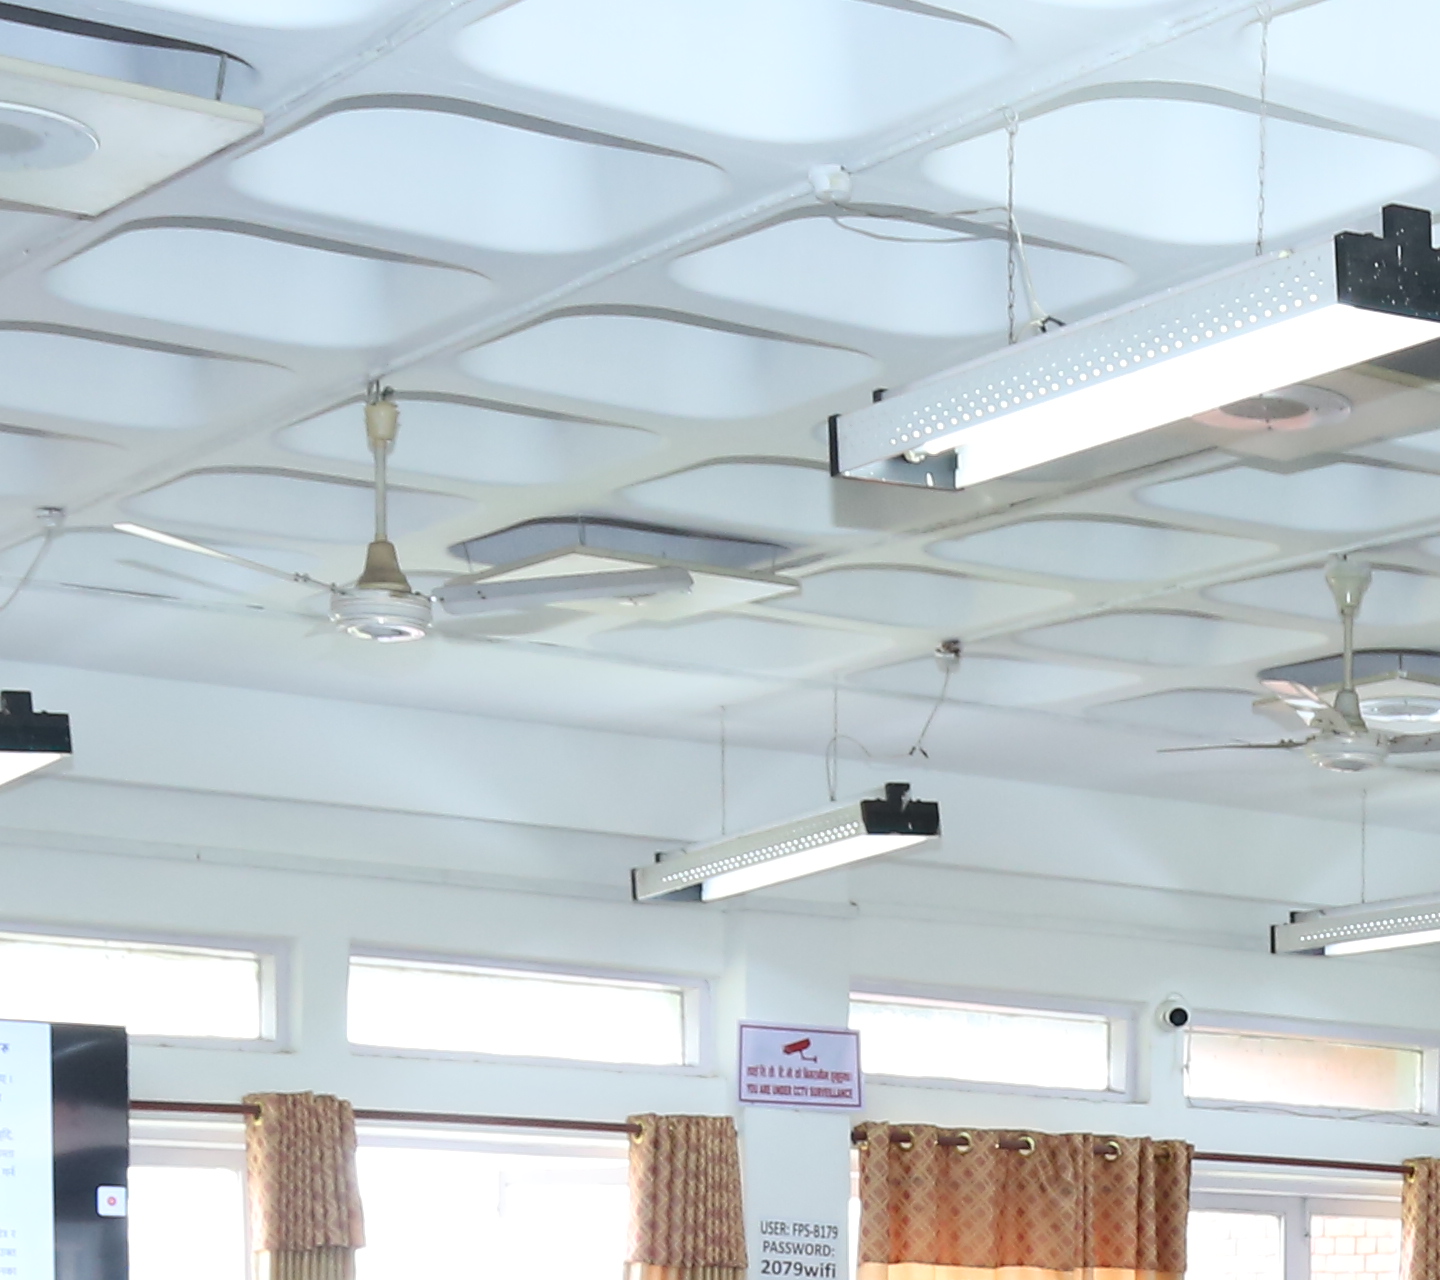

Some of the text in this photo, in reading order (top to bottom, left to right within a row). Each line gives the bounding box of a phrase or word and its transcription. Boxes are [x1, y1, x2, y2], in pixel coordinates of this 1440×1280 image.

[760, 1220, 790, 1236] USER:
[762, 1240, 835, 1257] PASSWORD:
[761, 1259, 836, 1278] 2079wifi
